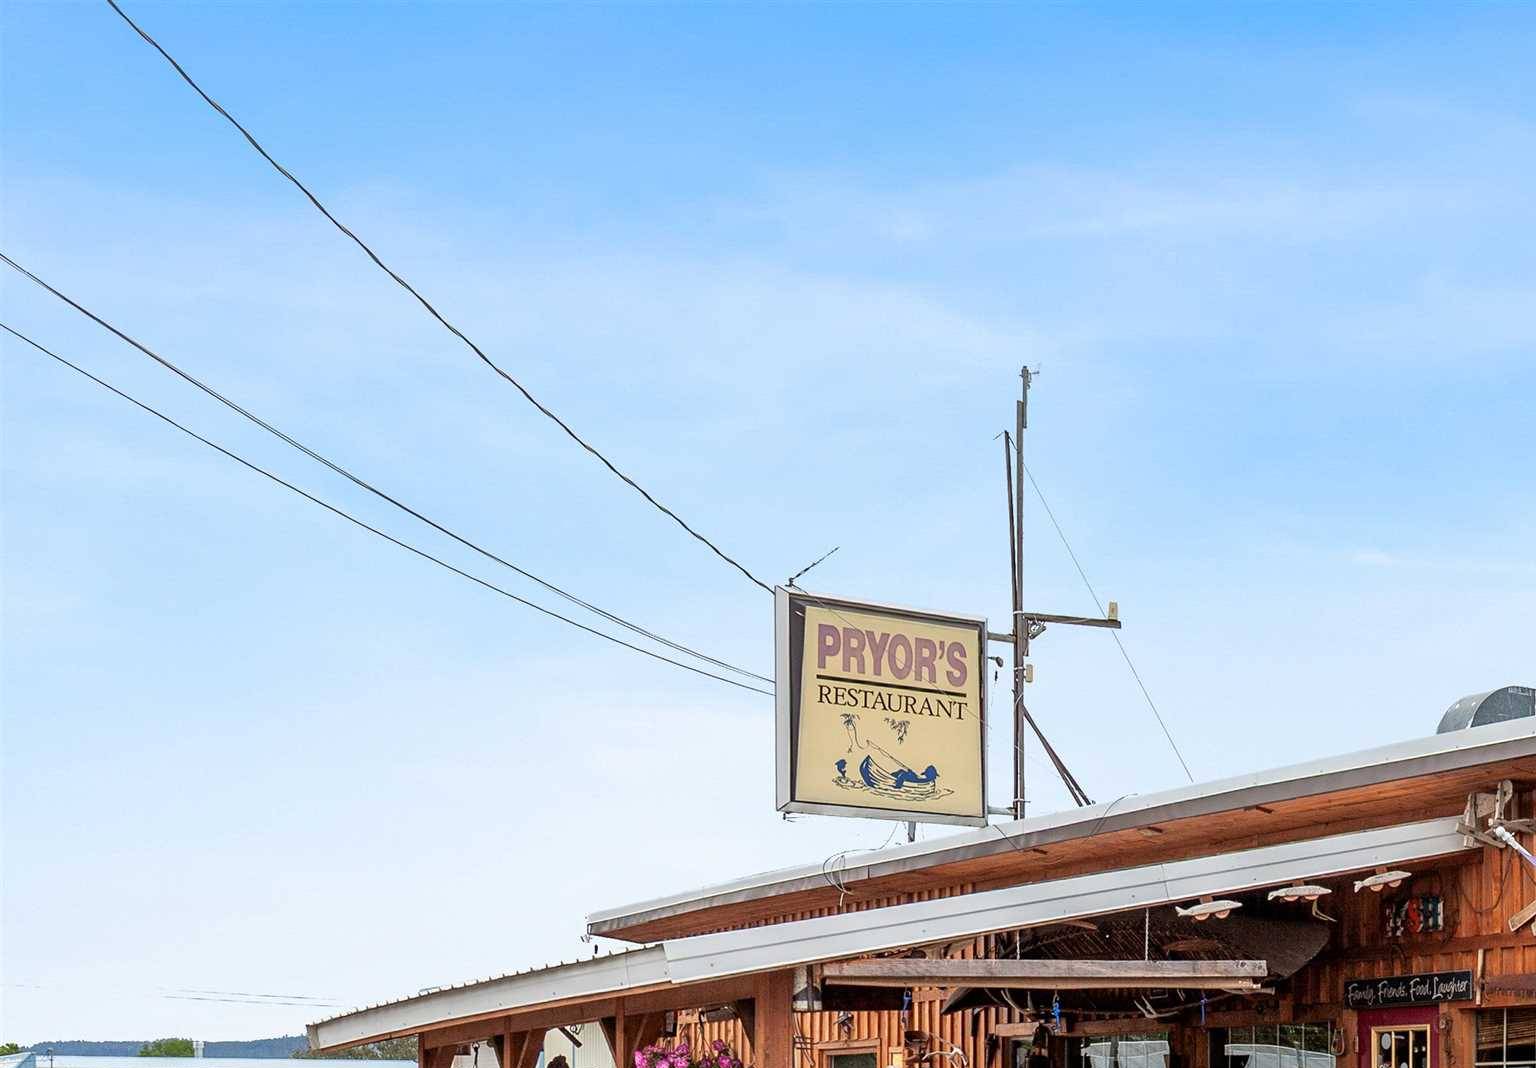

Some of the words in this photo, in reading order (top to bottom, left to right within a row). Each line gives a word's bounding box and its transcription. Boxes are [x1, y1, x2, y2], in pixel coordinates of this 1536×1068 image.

[816, 623, 968, 688] PRYOR'S
[817, 684, 968, 721] RESTAURANT
[1432, 976, 1469, 1000] Laughter
